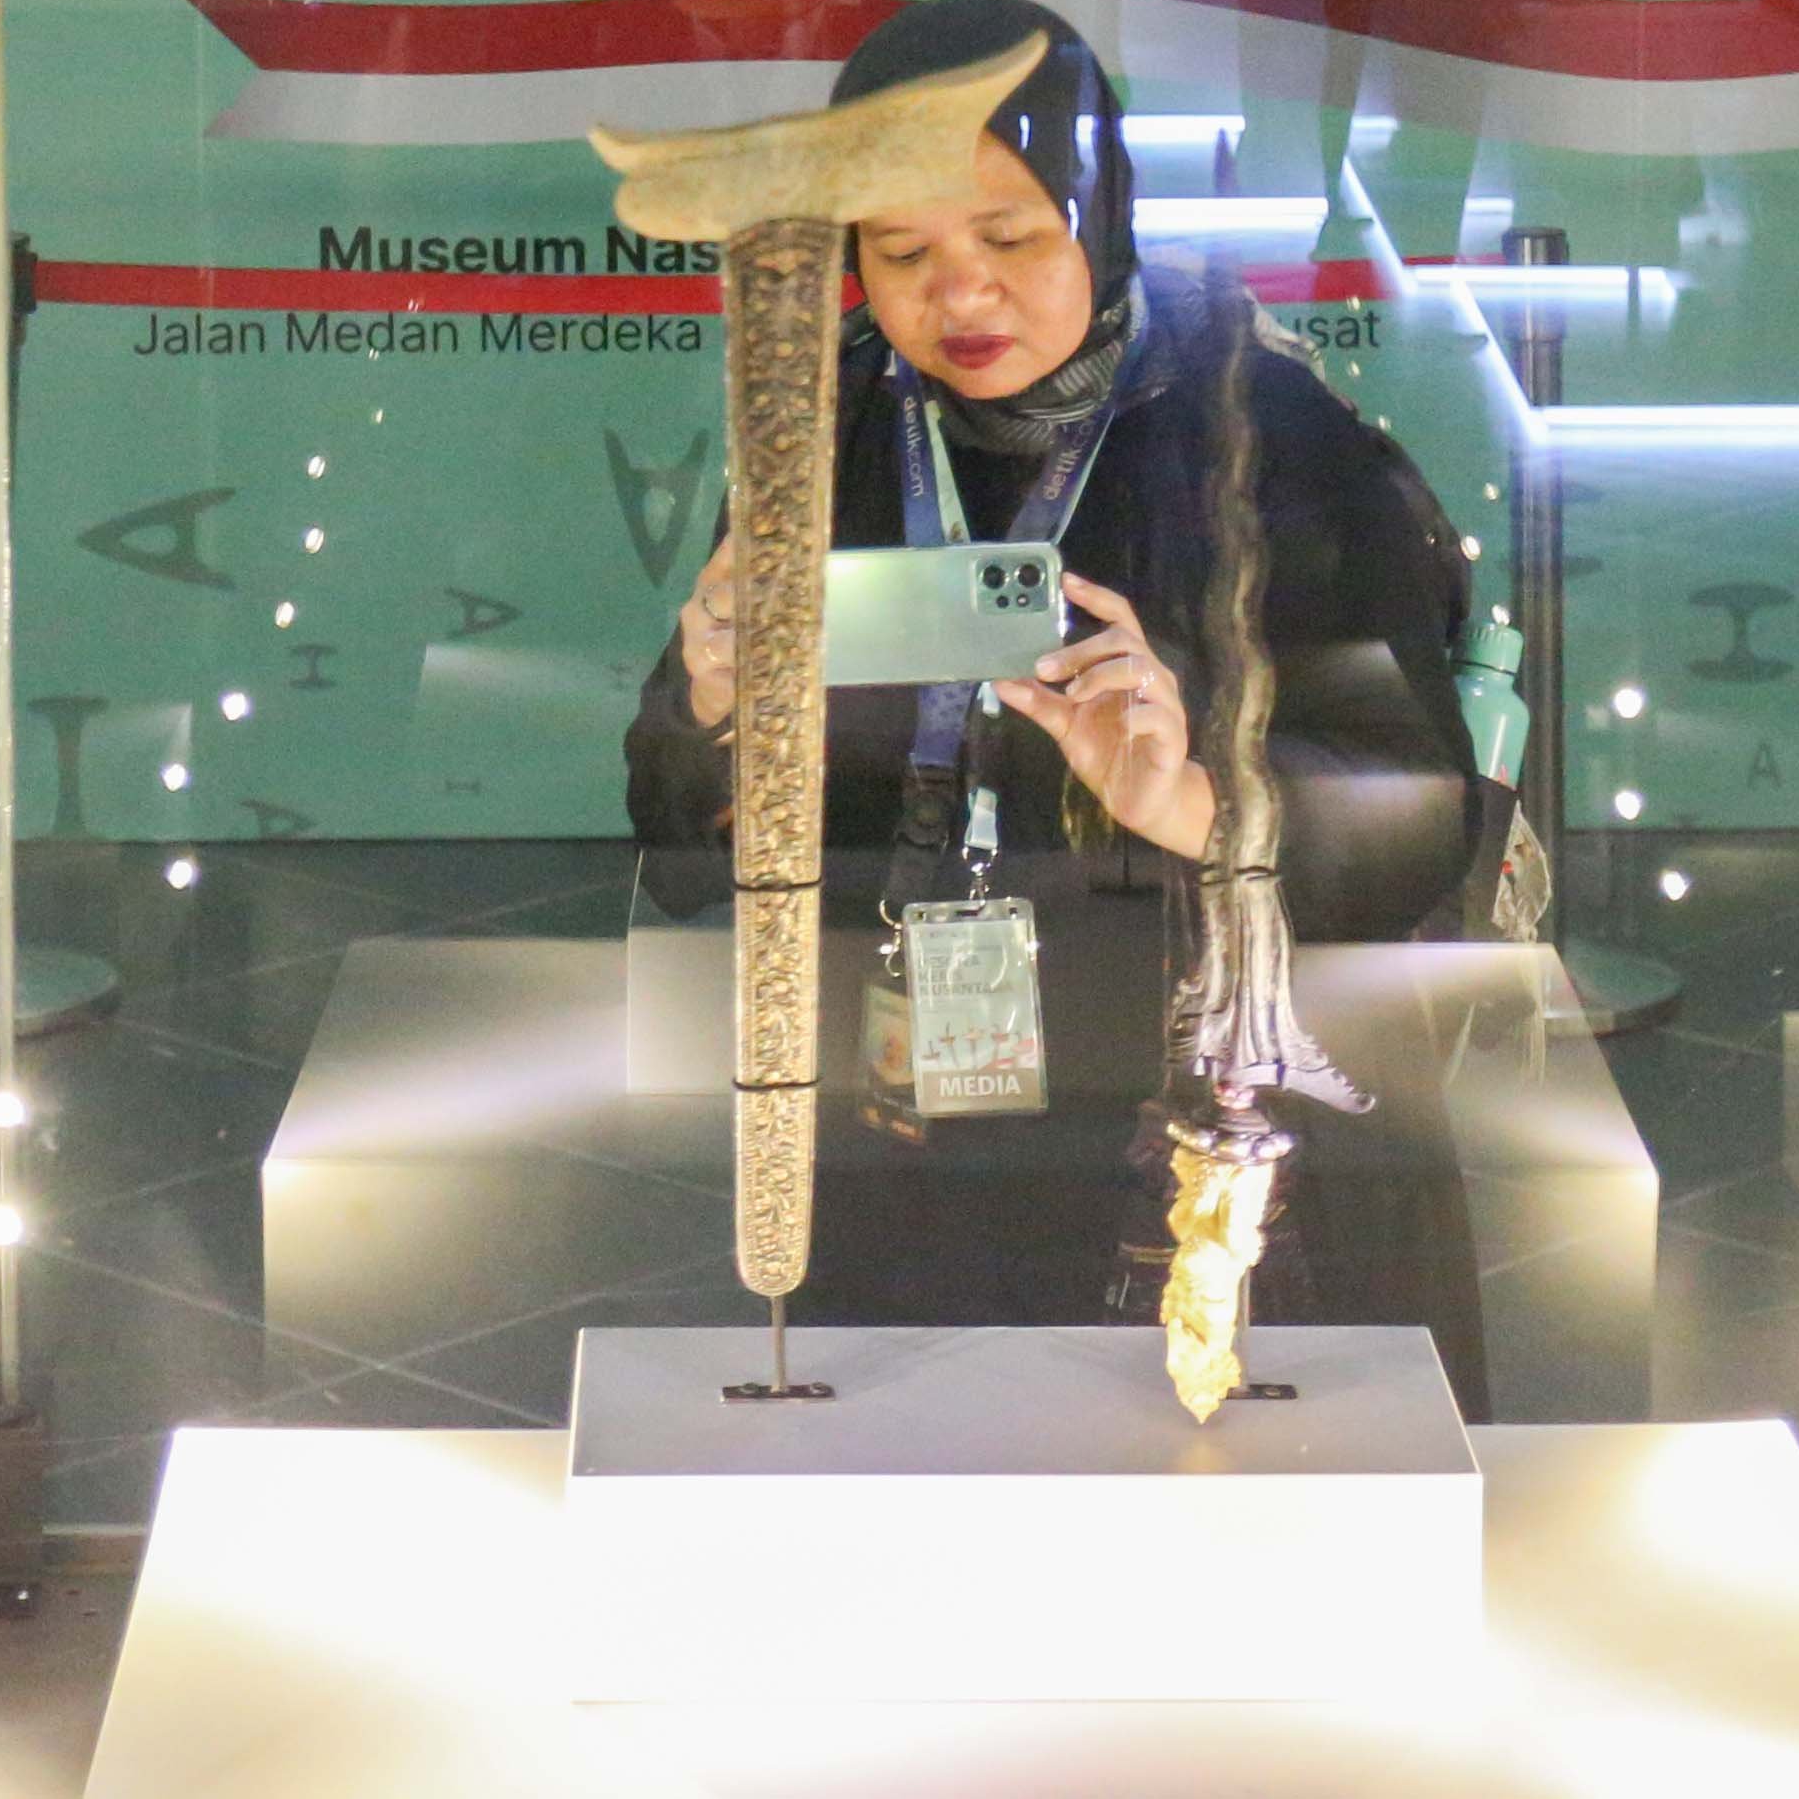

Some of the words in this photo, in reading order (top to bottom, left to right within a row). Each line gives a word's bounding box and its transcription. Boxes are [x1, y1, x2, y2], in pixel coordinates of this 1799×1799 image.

[319, 226, 586, 273] Museum
[133, 312, 266, 355] Jalan
[286, 312, 459, 354] Medan
[481, 312, 702, 354] Merdeka
[939, 1074, 1022, 1097] MEDIA
